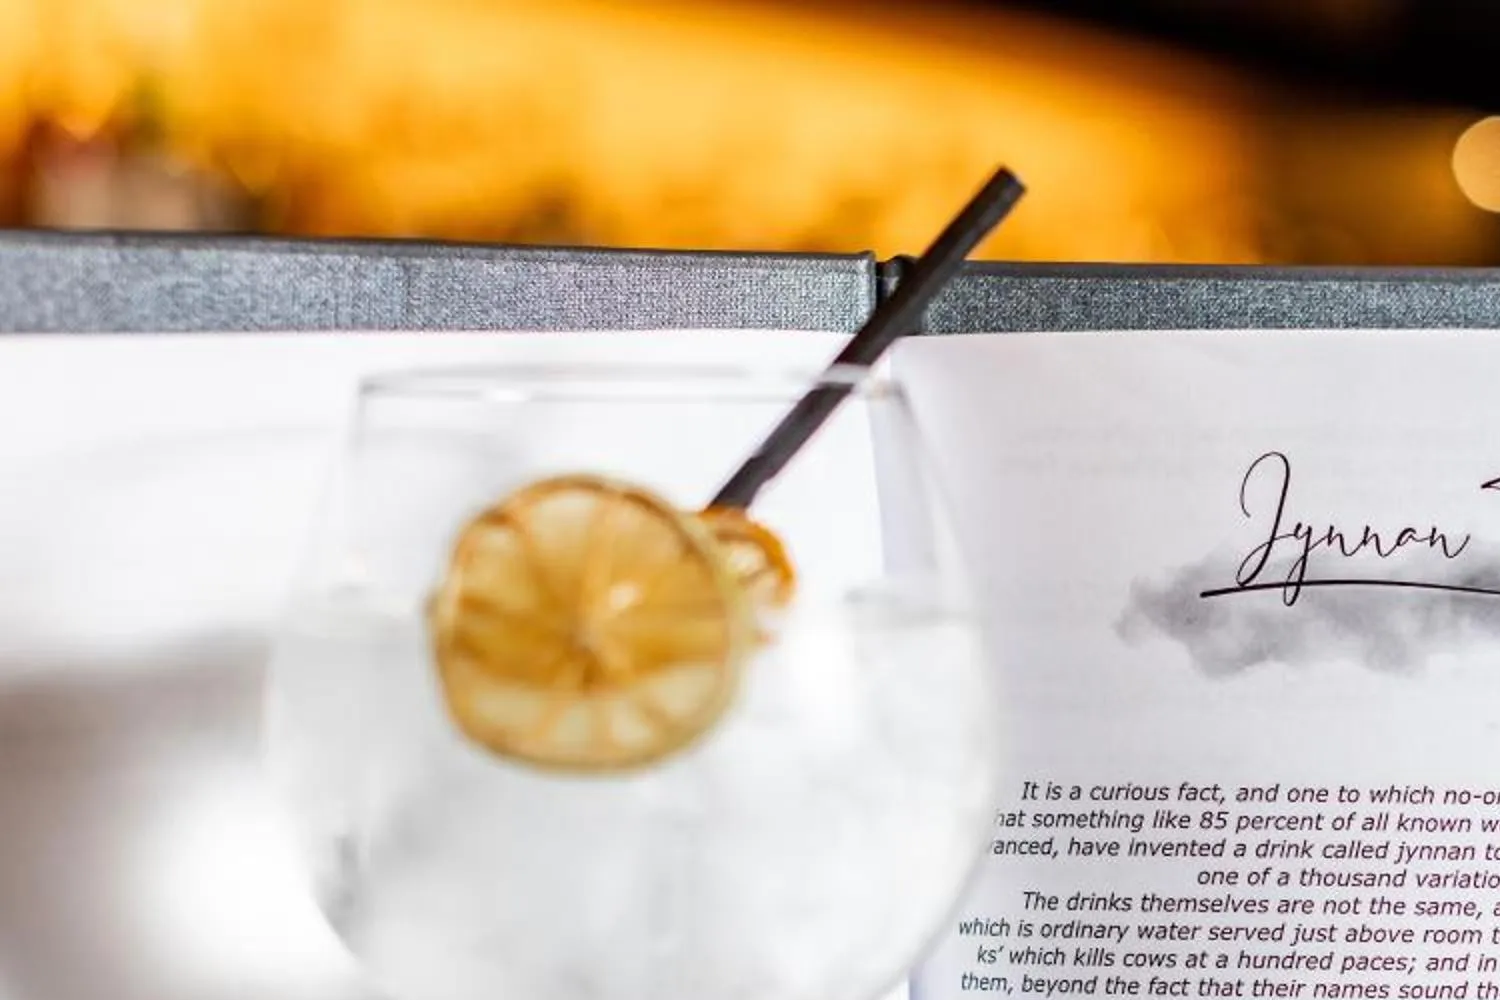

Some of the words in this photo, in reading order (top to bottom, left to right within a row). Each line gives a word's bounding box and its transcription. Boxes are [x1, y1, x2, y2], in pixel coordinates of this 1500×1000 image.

[1020, 780, 1041, 801] It
[1045, 780, 1063, 801] is
[1068, 785, 1083, 801] a
[1089, 781, 1172, 802] curious
[1177, 780, 1226, 807] fact,
[1235, 782, 1281, 804] and
[1286, 786, 1330, 804] one
[1337, 784, 1361, 804] to
[1368, 783, 1436, 806] which
[987, 836, 1059, 860] anced,
[1067, 835, 1121, 857] have
[1127, 836, 1227, 858] invented
[1232, 842, 1247, 859] a
[1254, 838, 1315, 860] drink
[1321, 839, 1391, 860] called
[1393, 840, 1476, 865] jynnan
[958, 917, 1011, 938] which
[1016, 919, 1035, 939] is
[1039, 919, 1131, 945] ordinary
[1137, 921, 1203, 941] water
[1207, 922, 1287, 943] served
[1289, 923, 1339, 947] just
[1344, 923, 1415, 945] above
[1422, 928, 1483, 945] room
